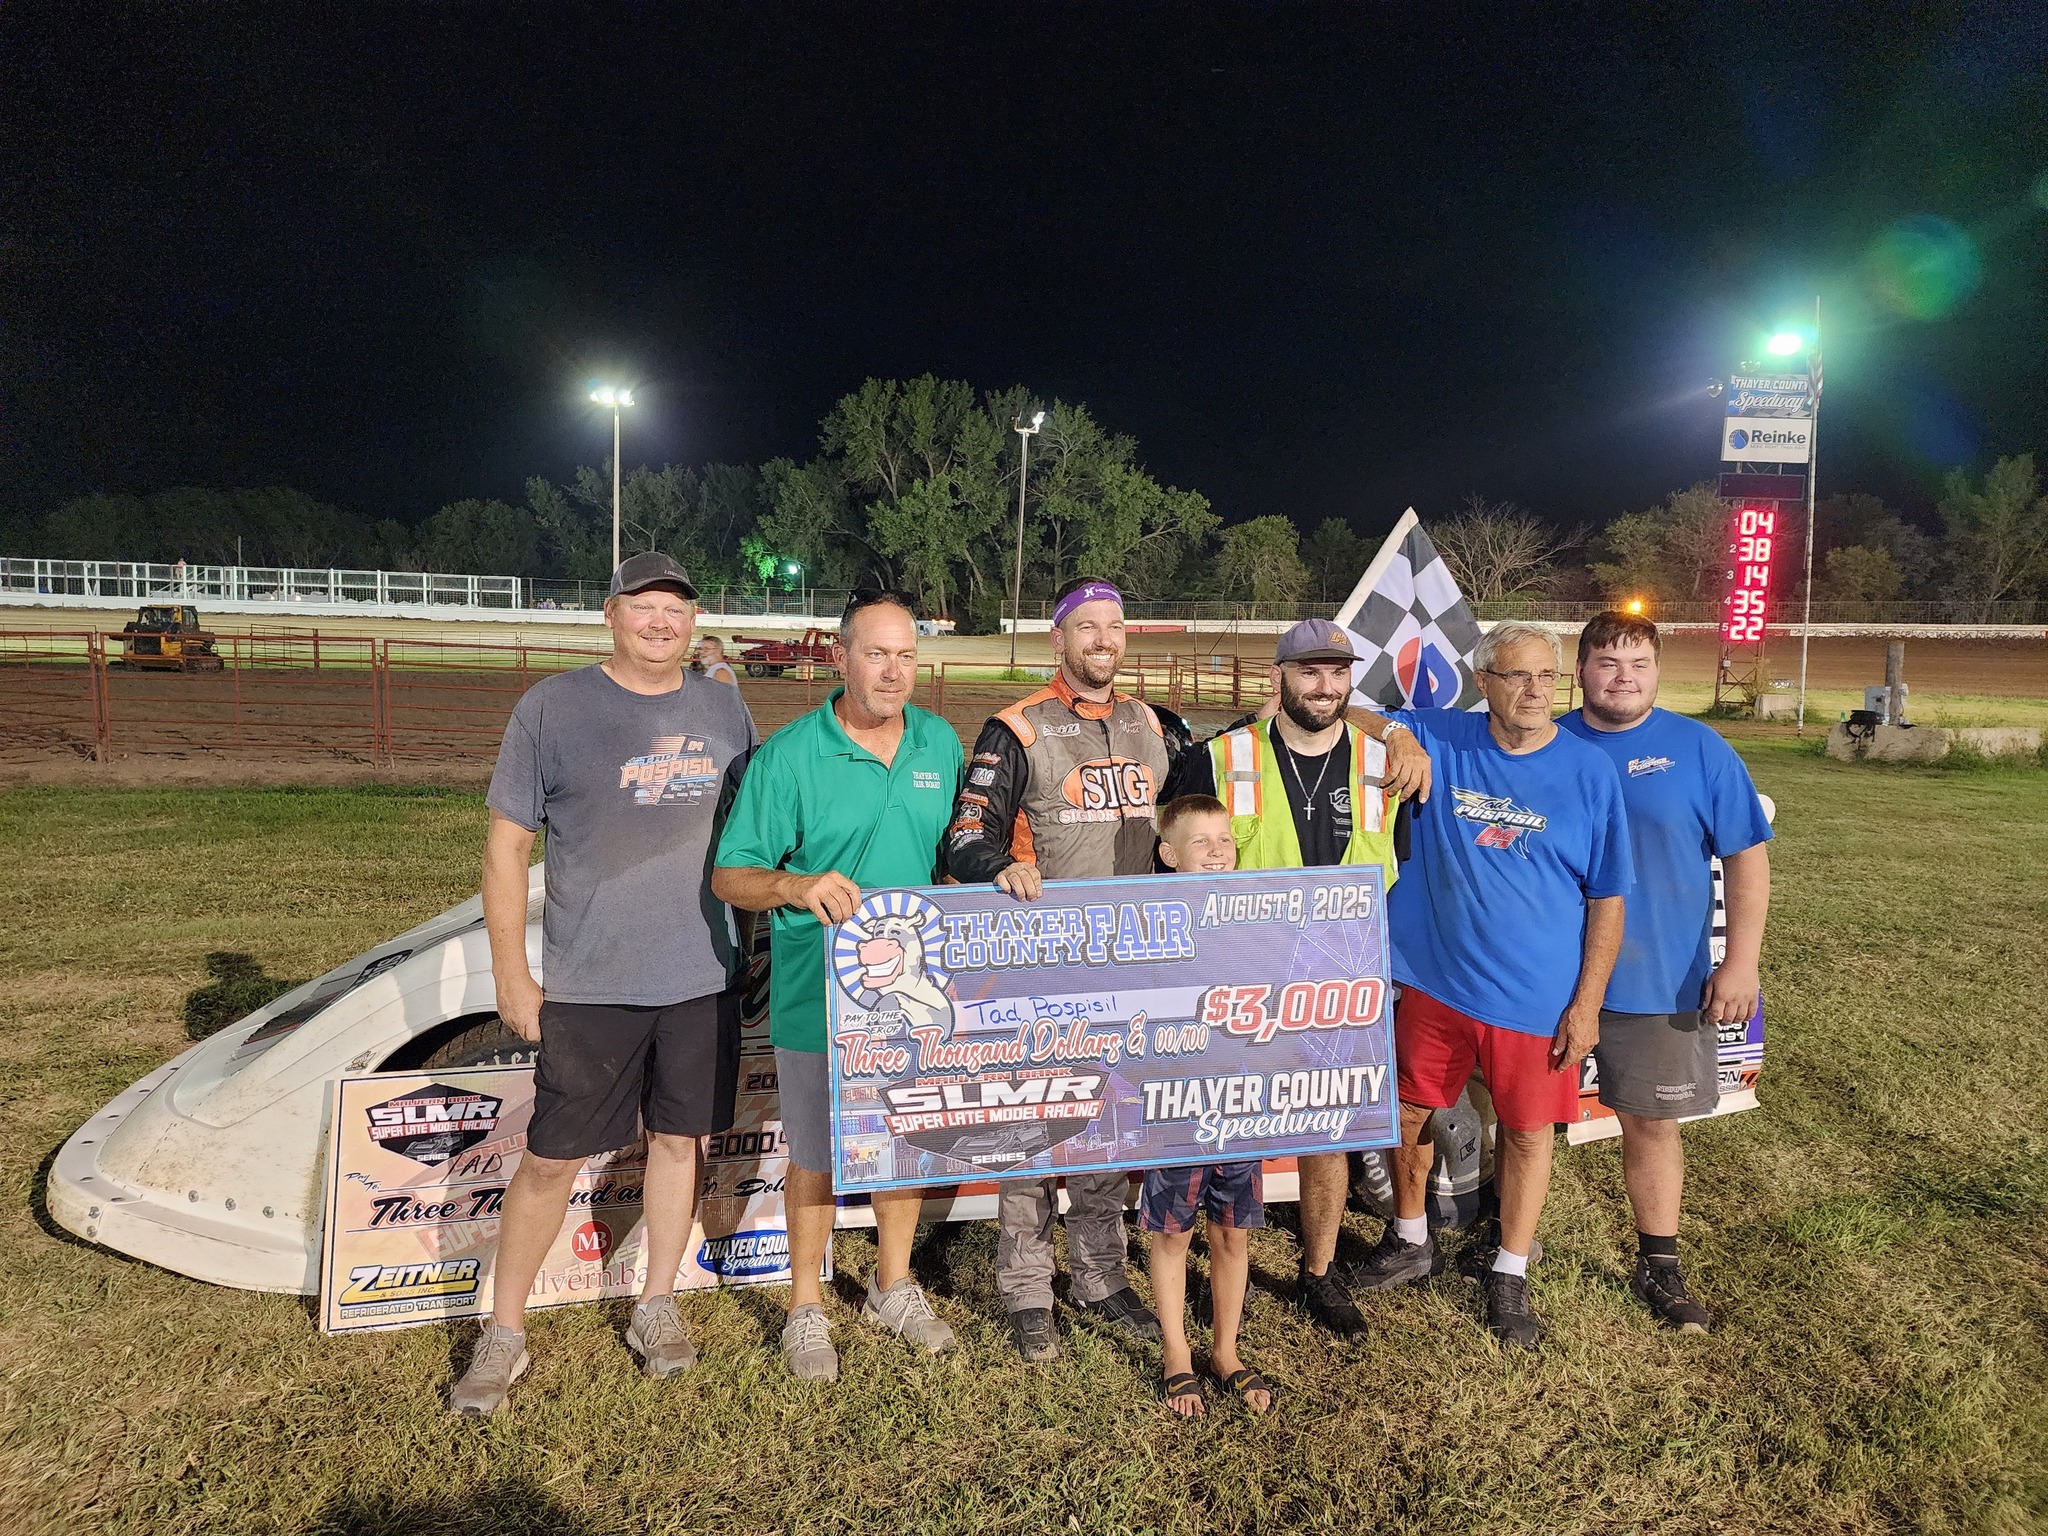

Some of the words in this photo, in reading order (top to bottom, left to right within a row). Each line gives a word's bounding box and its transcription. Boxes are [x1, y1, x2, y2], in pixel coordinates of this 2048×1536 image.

[1735, 379, 1770, 389] THAYER
[1735, 391, 1805, 413] Speedway
[1751, 430, 1806, 444] Reinke
[1740, 510, 1774, 535] 04
[1729, 544, 1736, 553] 2
[1739, 538, 1771, 562] 38
[1727, 571, 1734, 580] 3
[1745, 565, 1768, 587] 14
[1724, 597, 1731, 606] 4
[1733, 590, 1765, 614] 35
[1721, 623, 1729, 632] 5
[1729, 616, 1763, 640] 22
[620, 757, 719, 788] POSPISIL
[1081, 763, 1149, 810] SIG
[1478, 798, 1512, 810] Tad
[1455, 804, 1546, 831] POSPISIL
[1311, 884, 1373, 922] 2025
[943, 907, 1085, 941] THAYER
[1085, 899, 1196, 963] FAIR
[944, 935, 1085, 969] COUNTY
[844, 1013, 864, 1023] PAY
[866, 1012, 879, 1021] TO
[881, 1011, 901, 1020] THE
[963, 1000, 1022, 1025] Tad
[1028, 995, 1117, 1019] Pospisil
[1204, 977, 1385, 1043] $3,000
[835, 1032, 909, 1077] Three
[910, 1021, 1029, 1073] Thousand
[1030, 1017, 1123, 1065] Dollars
[1154, 1023, 1209, 1054] 00/100
[1017, 1067, 1075, 1079] BANK
[887, 1075, 1101, 1113] SLMR
[1143, 1074, 1263, 1121] THAYER
[1270, 1065, 1387, 1110] COUNTY
[371, 1101, 498, 1126] SLMR
[890, 1112, 946, 1133] SUPER
[948, 1109, 986, 1126] LATE
[989, 1105, 1040, 1123] MODEL
[1043, 1100, 1100, 1120] RACING
[371, 1124, 404, 1140] SUPER
[405, 1123, 428, 1134] LATE
[430, 1121, 461, 1133] MODEL
[463, 1119, 495, 1130] RACING
[1194, 1103, 1355, 1151] Speedway
[416, 1152, 450, 1162] SERIES
[971, 1151, 1026, 1164] SERIES
[369, 1195, 461, 1228] Three
[577, 1231, 607, 1252] MB
[703, 1237, 756, 1261] THAYER
[756, 1235, 789, 1256] COUN
[722, 1251, 790, 1275] Speedway
[339, 1258, 480, 1305] ZEITNER
[340, 1303, 414, 1319] REFRIGERATED
[417, 1296, 476, 1312] TRANSPORT
